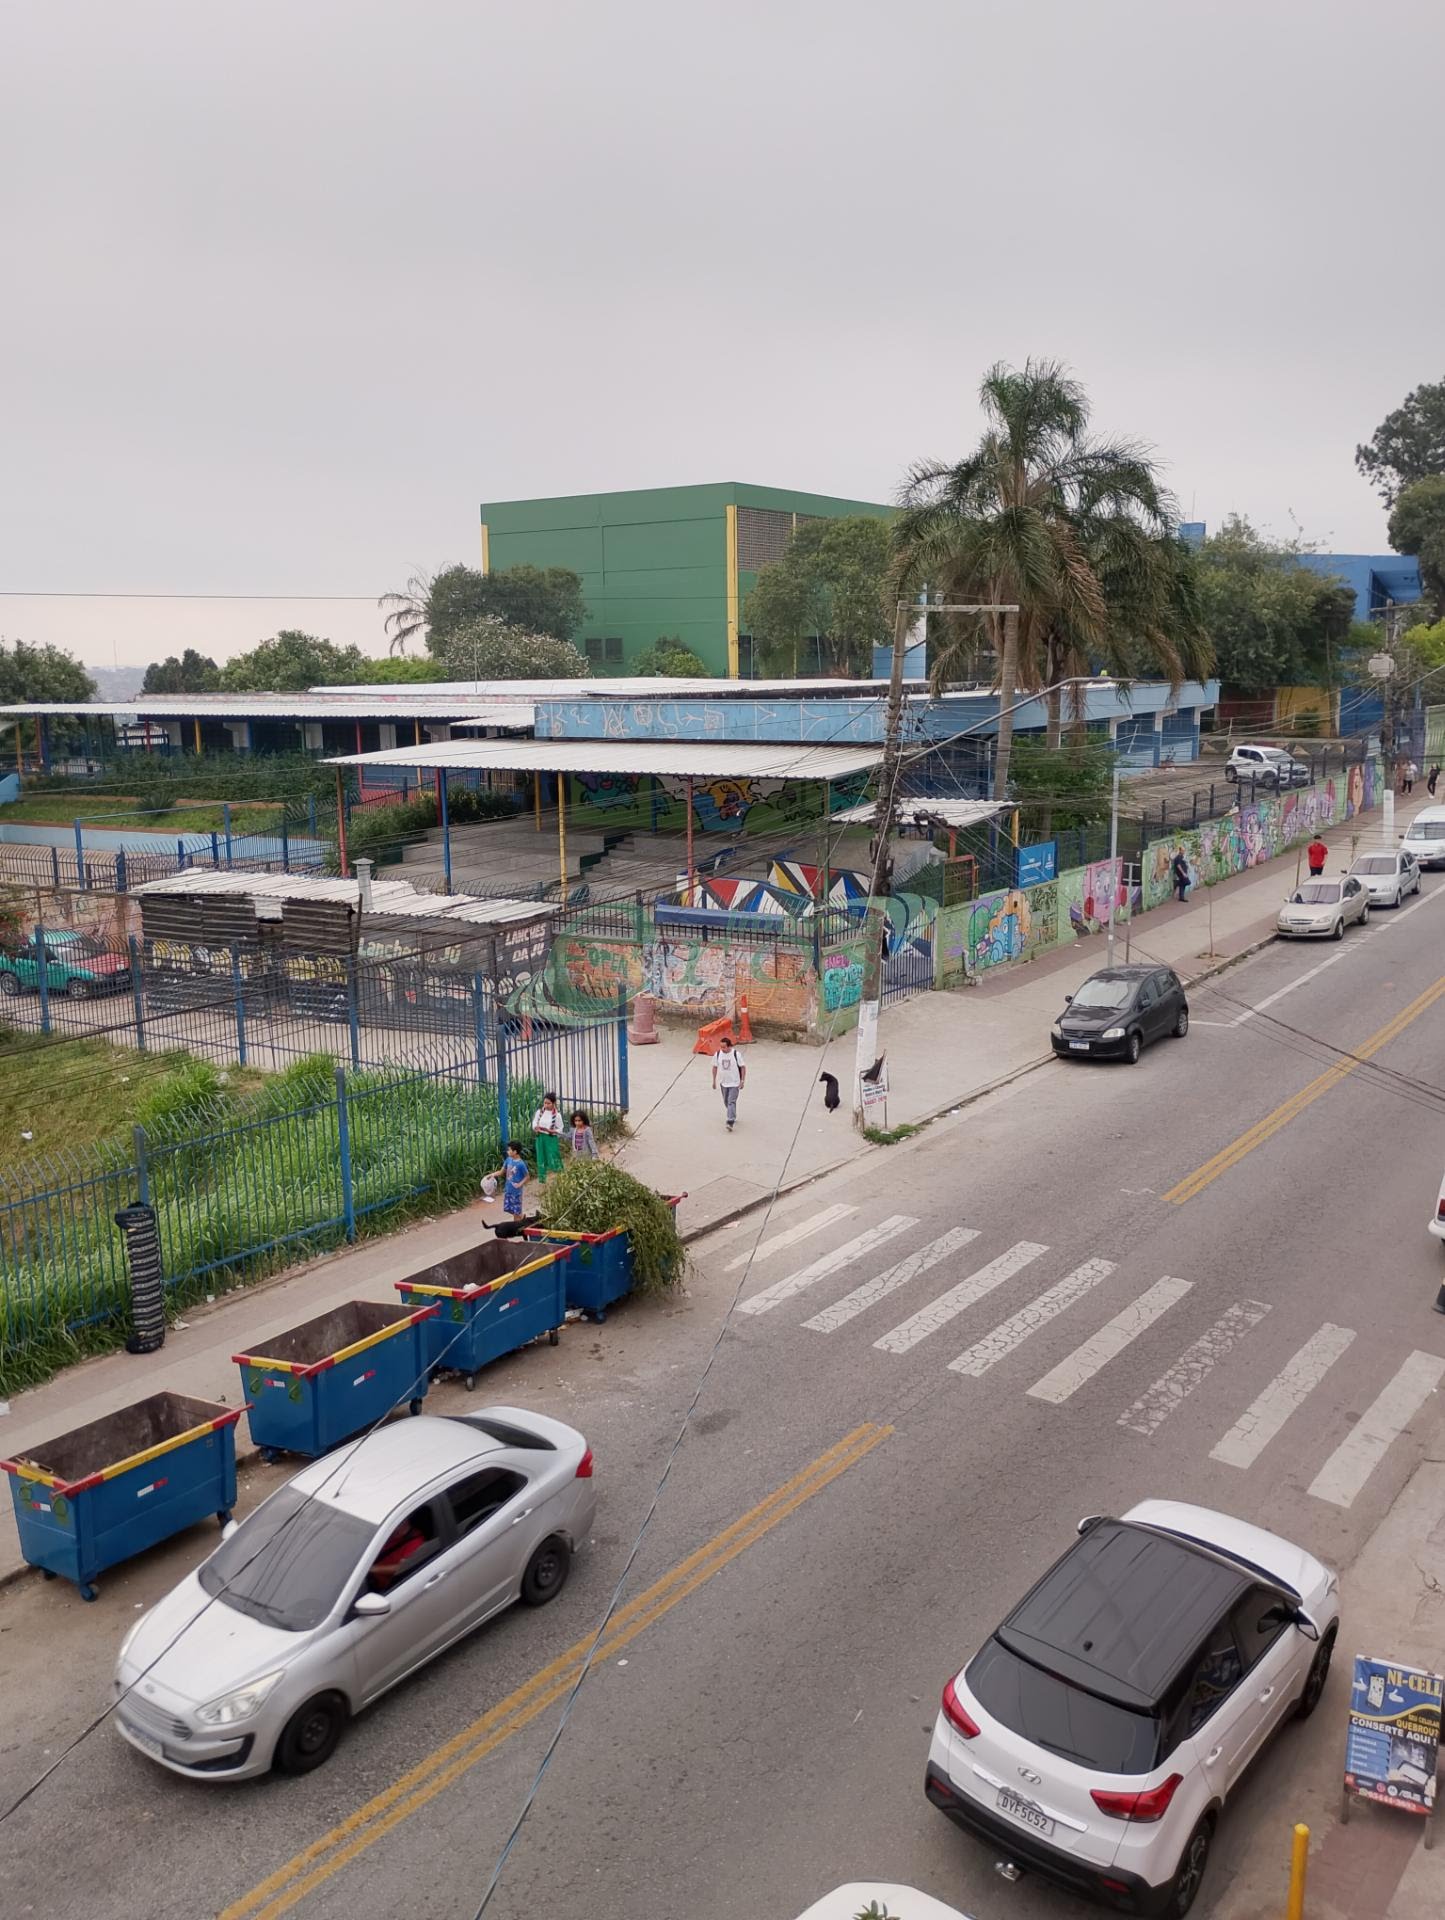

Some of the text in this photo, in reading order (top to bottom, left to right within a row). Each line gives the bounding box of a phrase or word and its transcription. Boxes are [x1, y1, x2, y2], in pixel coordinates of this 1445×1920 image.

[1387, 1668, 1442, 1696] NI-CELL
[1351, 1717, 1404, 1737] CONSERTE
[1406, 1731, 1431, 1745] AQUI
[1396, 1719, 1440, 1737] QUEBROU?
[1002, 1796, 1048, 1831] DYF5C52
